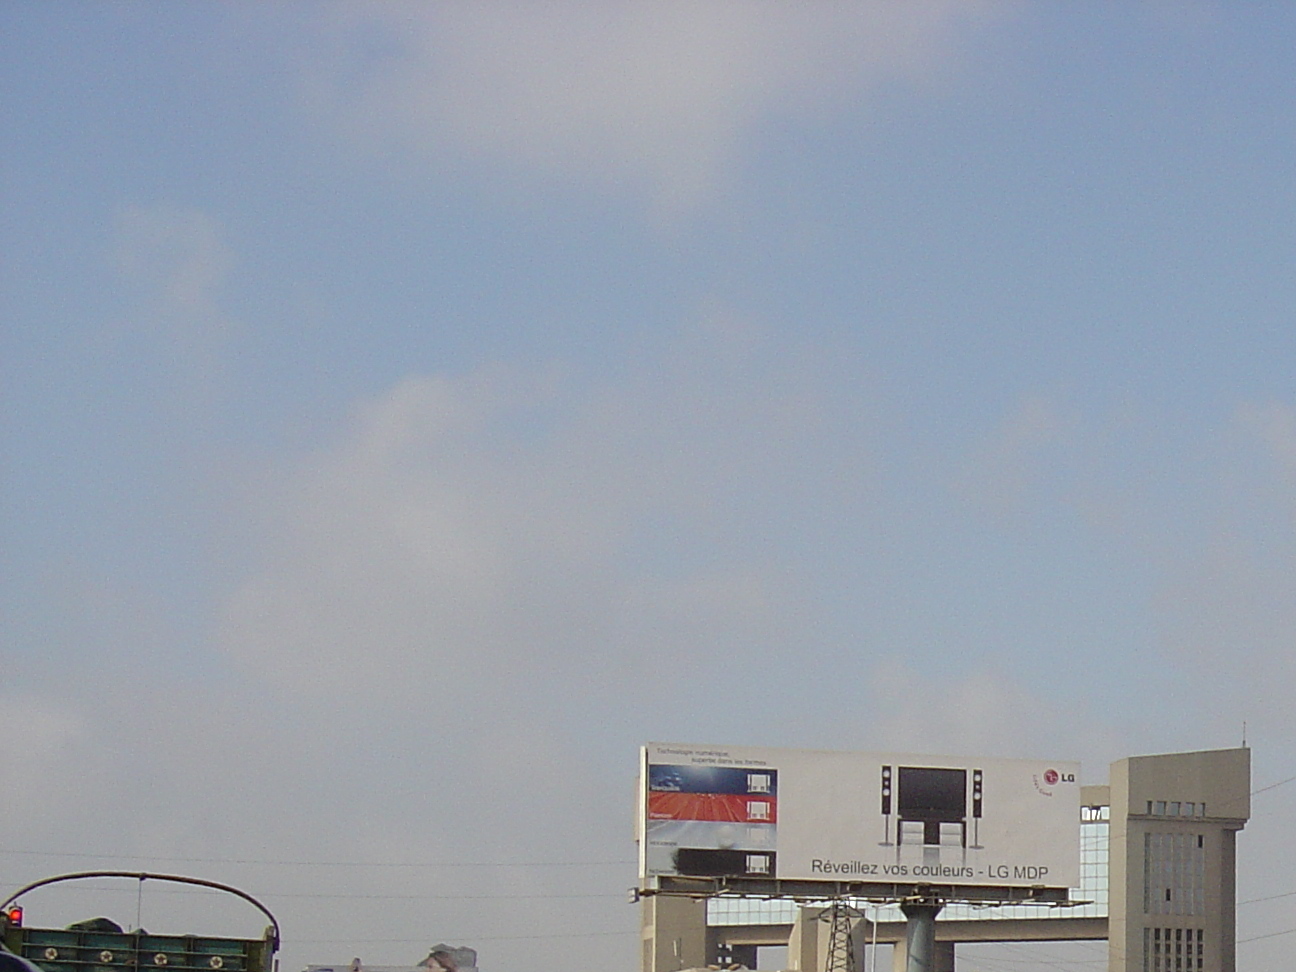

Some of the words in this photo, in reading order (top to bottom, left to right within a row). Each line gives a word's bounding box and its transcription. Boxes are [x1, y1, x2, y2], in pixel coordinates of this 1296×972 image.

[1061, 773, 1075, 783] LG
[812, 859, 878, 875] Réveillez
[883, 864, 908, 876] vos
[913, 863, 974, 878] couleurs
[988, 865, 1009, 879] LG
[1014, 866, 1049, 880] MDP
